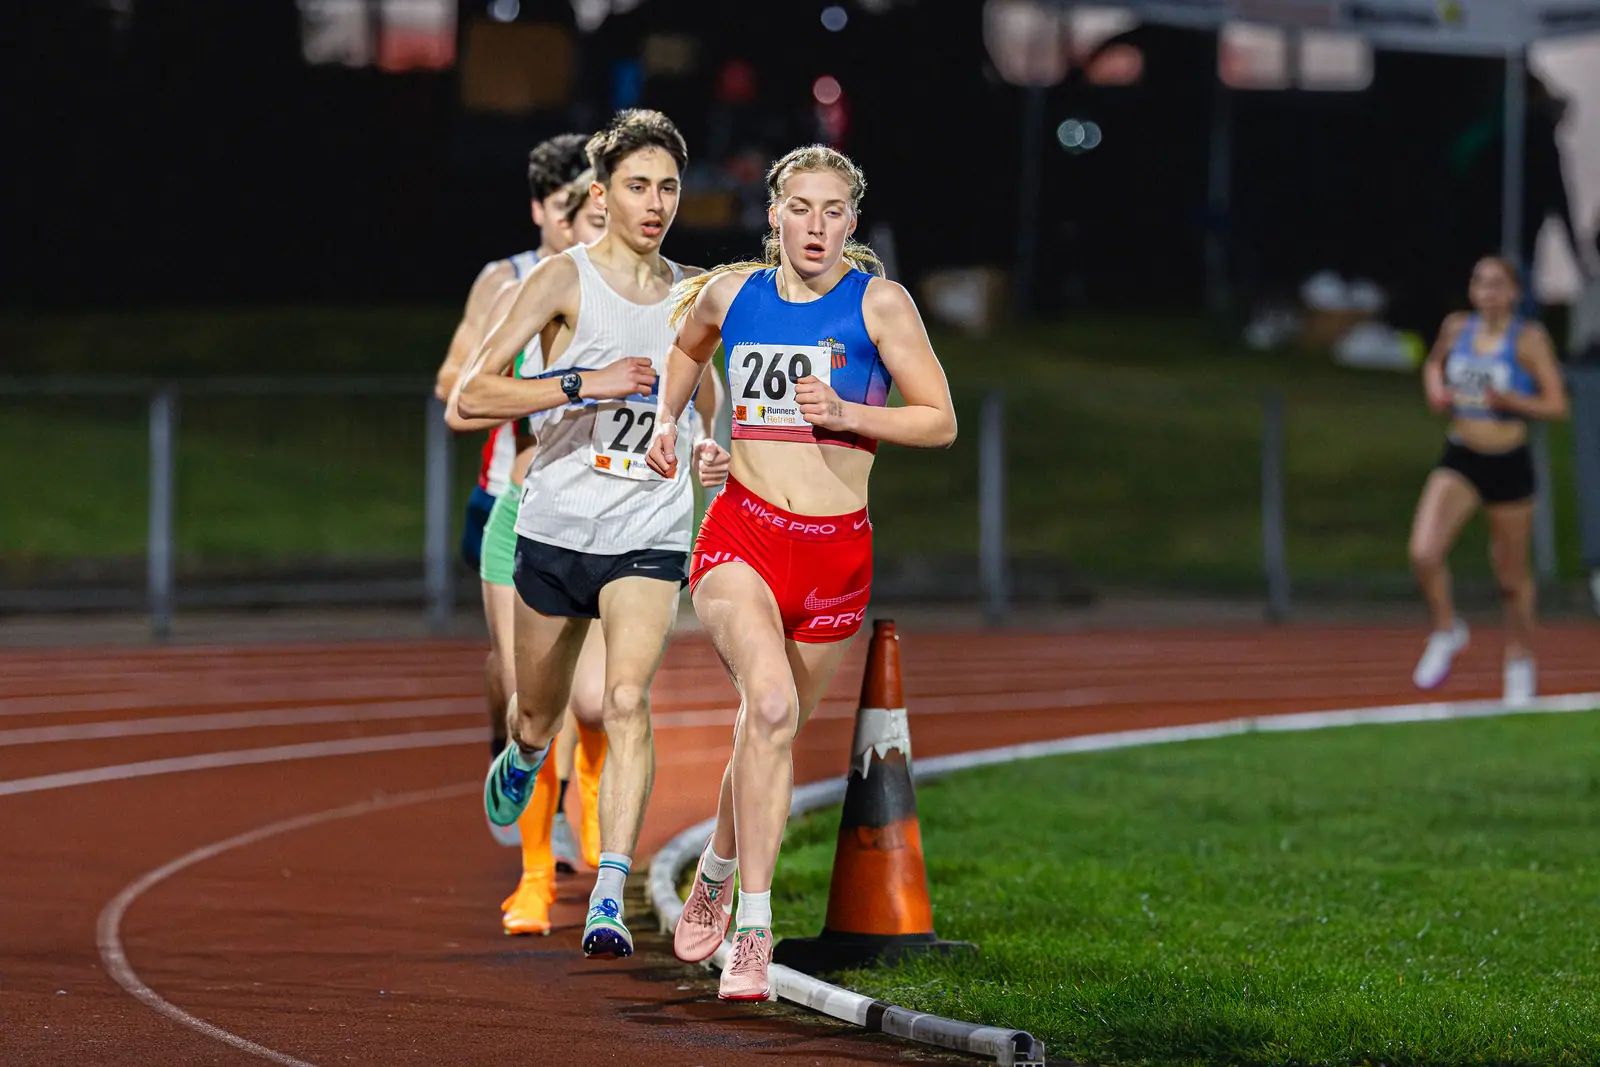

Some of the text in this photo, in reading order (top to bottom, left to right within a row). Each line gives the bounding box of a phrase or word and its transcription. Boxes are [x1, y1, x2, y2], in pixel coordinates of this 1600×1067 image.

[742, 352, 811, 401] 269
[767, 415, 796, 424] Retreat
[741, 497, 836, 535] NIKE PRO
